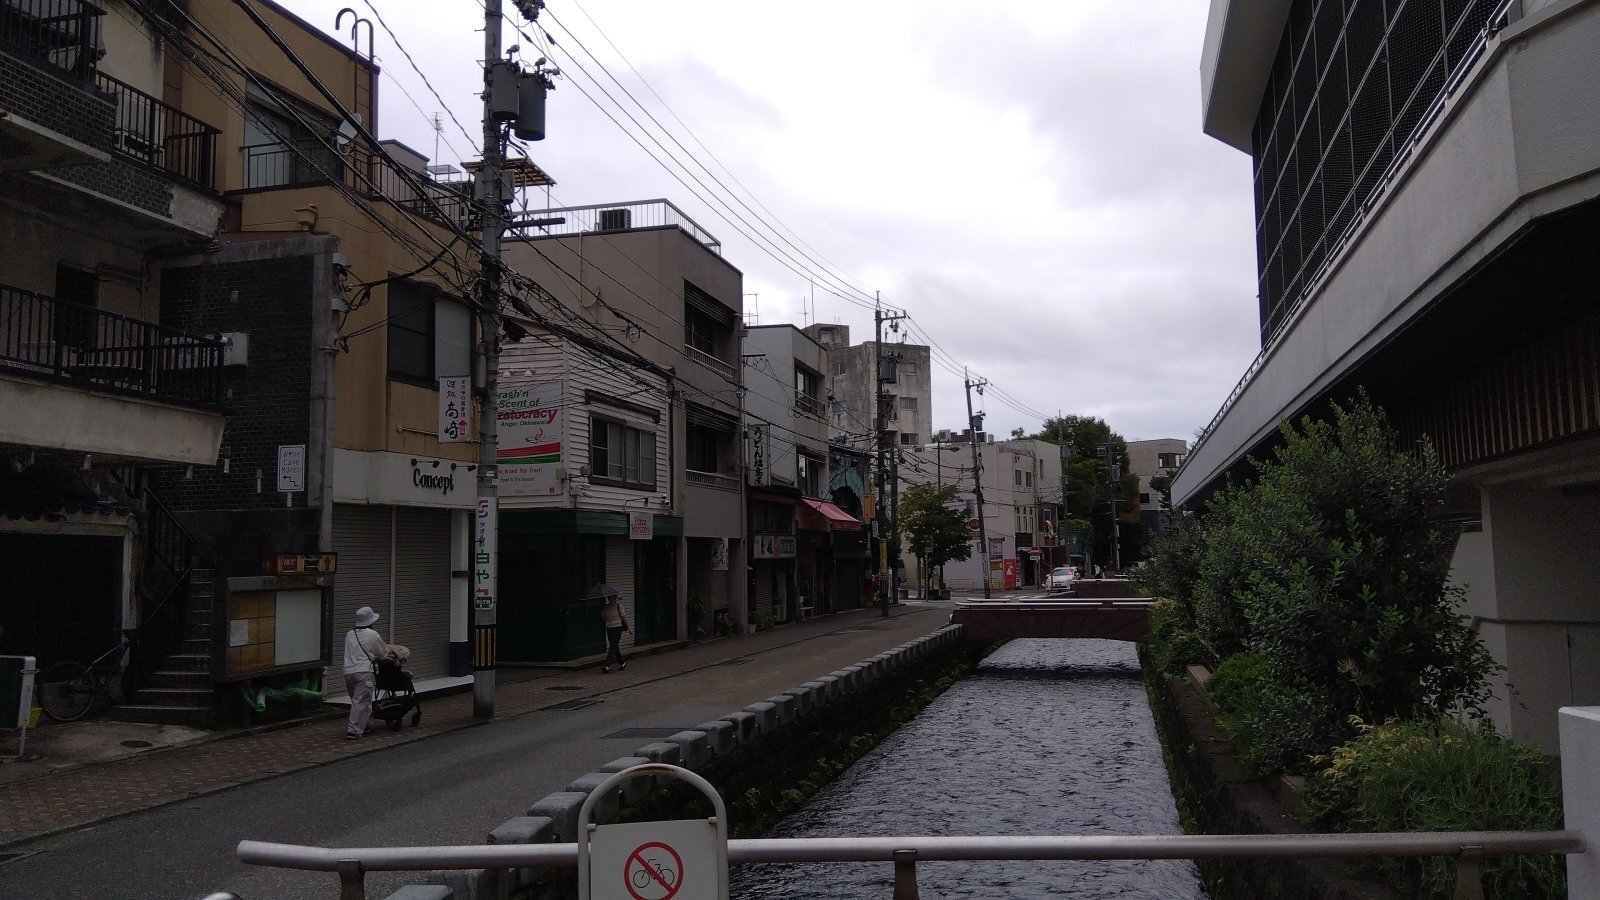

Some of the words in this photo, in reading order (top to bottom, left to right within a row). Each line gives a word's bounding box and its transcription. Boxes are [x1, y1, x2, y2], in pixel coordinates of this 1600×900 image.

[499, 400, 527, 408] Scent
[530, 398, 540, 406] of
[413, 467, 454, 494] Concept
